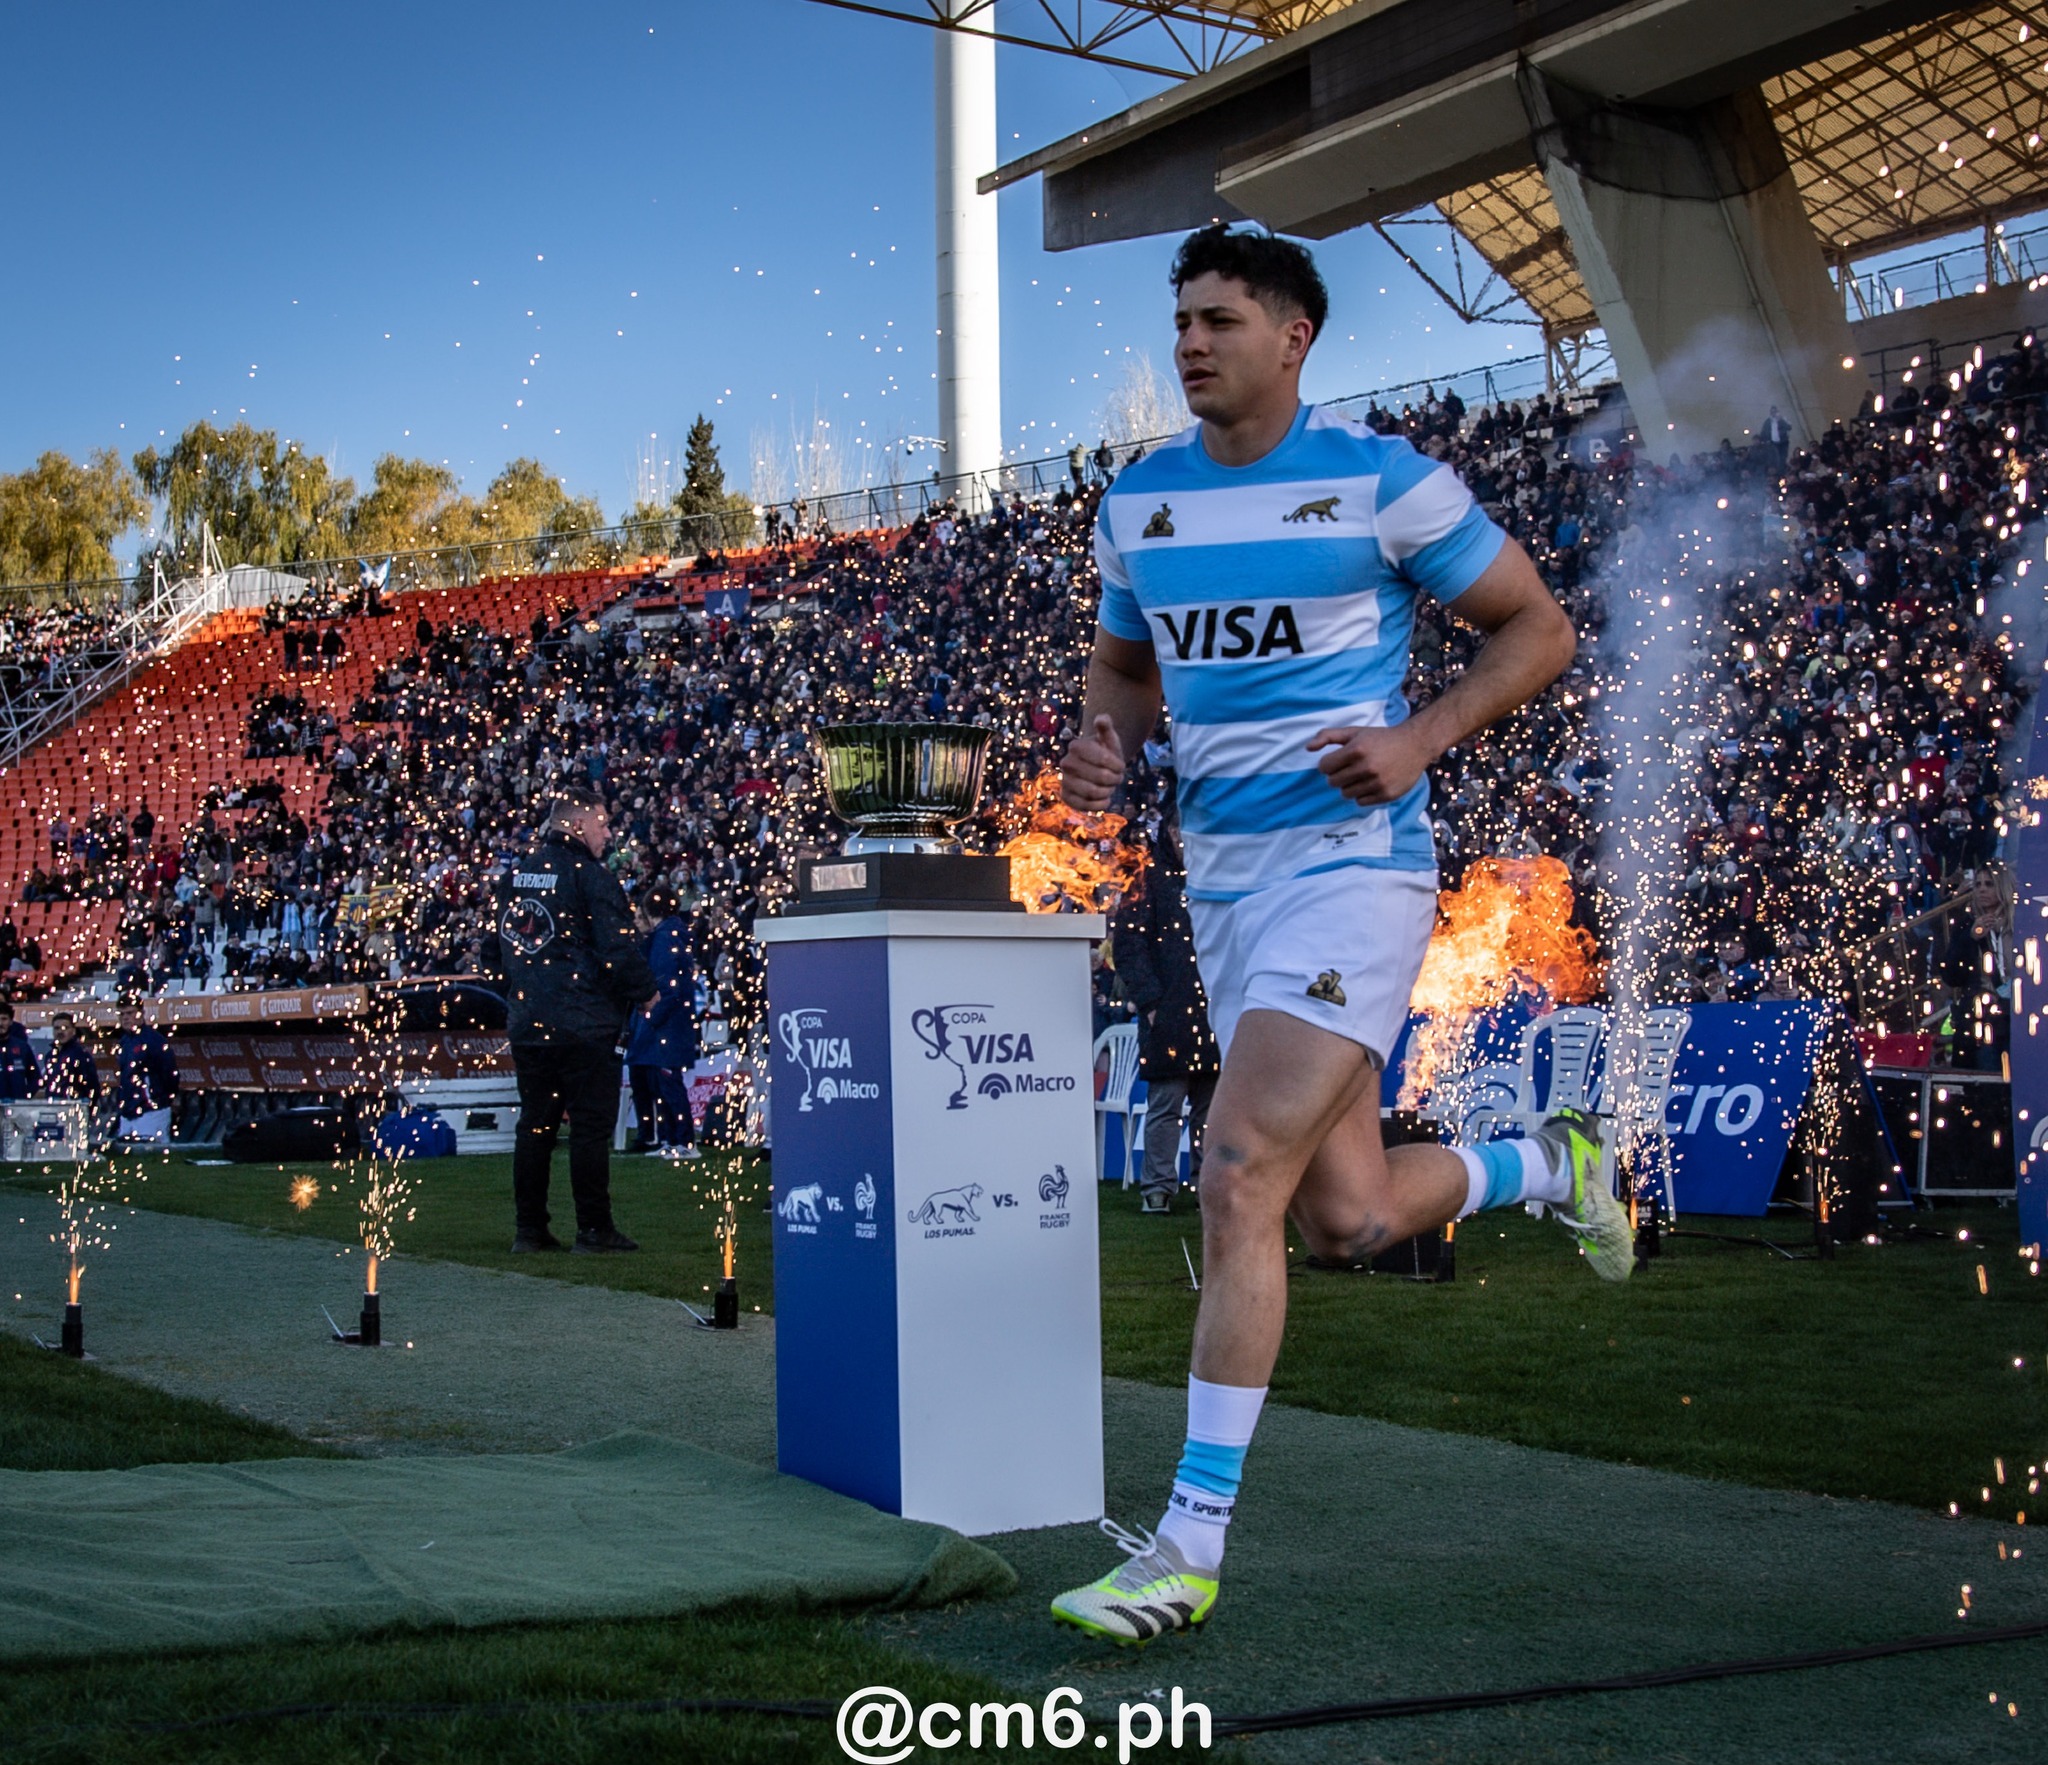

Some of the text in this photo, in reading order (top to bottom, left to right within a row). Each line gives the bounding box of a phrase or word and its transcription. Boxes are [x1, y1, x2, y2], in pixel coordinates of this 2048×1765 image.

[720, 593, 736, 615] A
[1153, 604, 1304, 660] VISA
[219, 1000, 250, 1016] GATORADE
[268, 998, 302, 1014] GATORADE
[801, 1016, 823, 1029] COPA
[951, 1012, 987, 1024] COPA
[456, 1037, 512, 1056] GATORAD
[805, 1037, 853, 1069] VISA
[958, 1033, 1035, 1064] VISA
[840, 1079, 879, 1098] Macro
[1016, 1074, 1075, 1093] Macro
[1040, 1213, 1070, 1221] FRANCE
[1040, 1219, 1071, 1229] RUGBY
[855, 1229, 877, 1239] RUGBY
[924, 1229, 941, 1239] LOS
